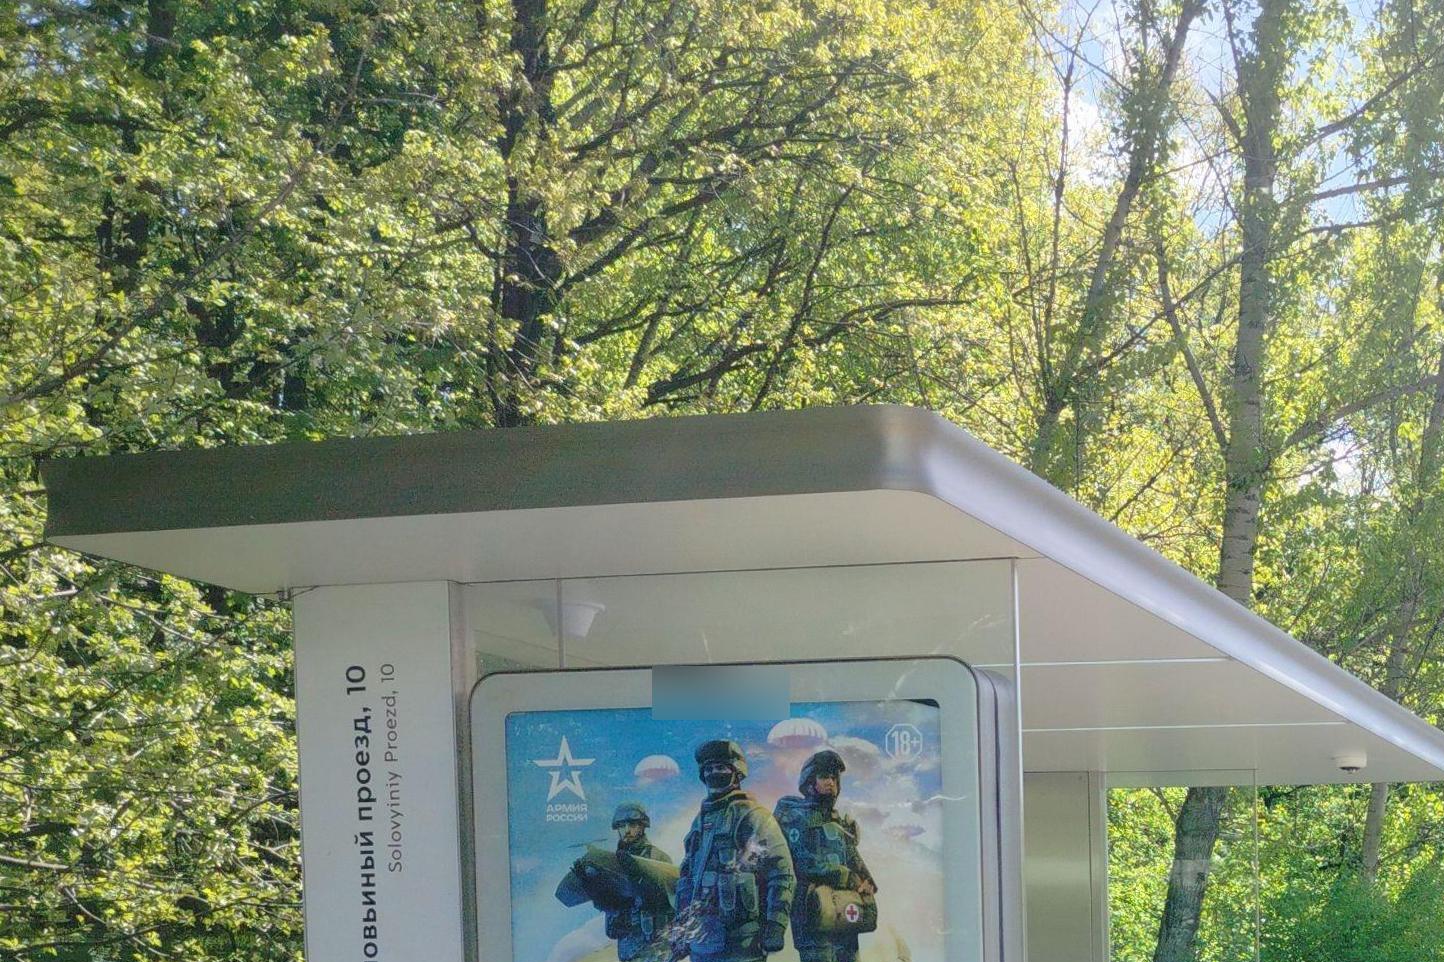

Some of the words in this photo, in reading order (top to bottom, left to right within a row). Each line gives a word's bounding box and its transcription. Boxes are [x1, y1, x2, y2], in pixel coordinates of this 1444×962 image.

[345, 664, 366, 695] 10
[380, 663, 395, 684] 10
[382, 690, 399, 763] Proezd,
[891, 730, 920, 753] 18+
[352, 705, 377, 822] проезд,
[384, 770, 402, 873] Solovyiniy
